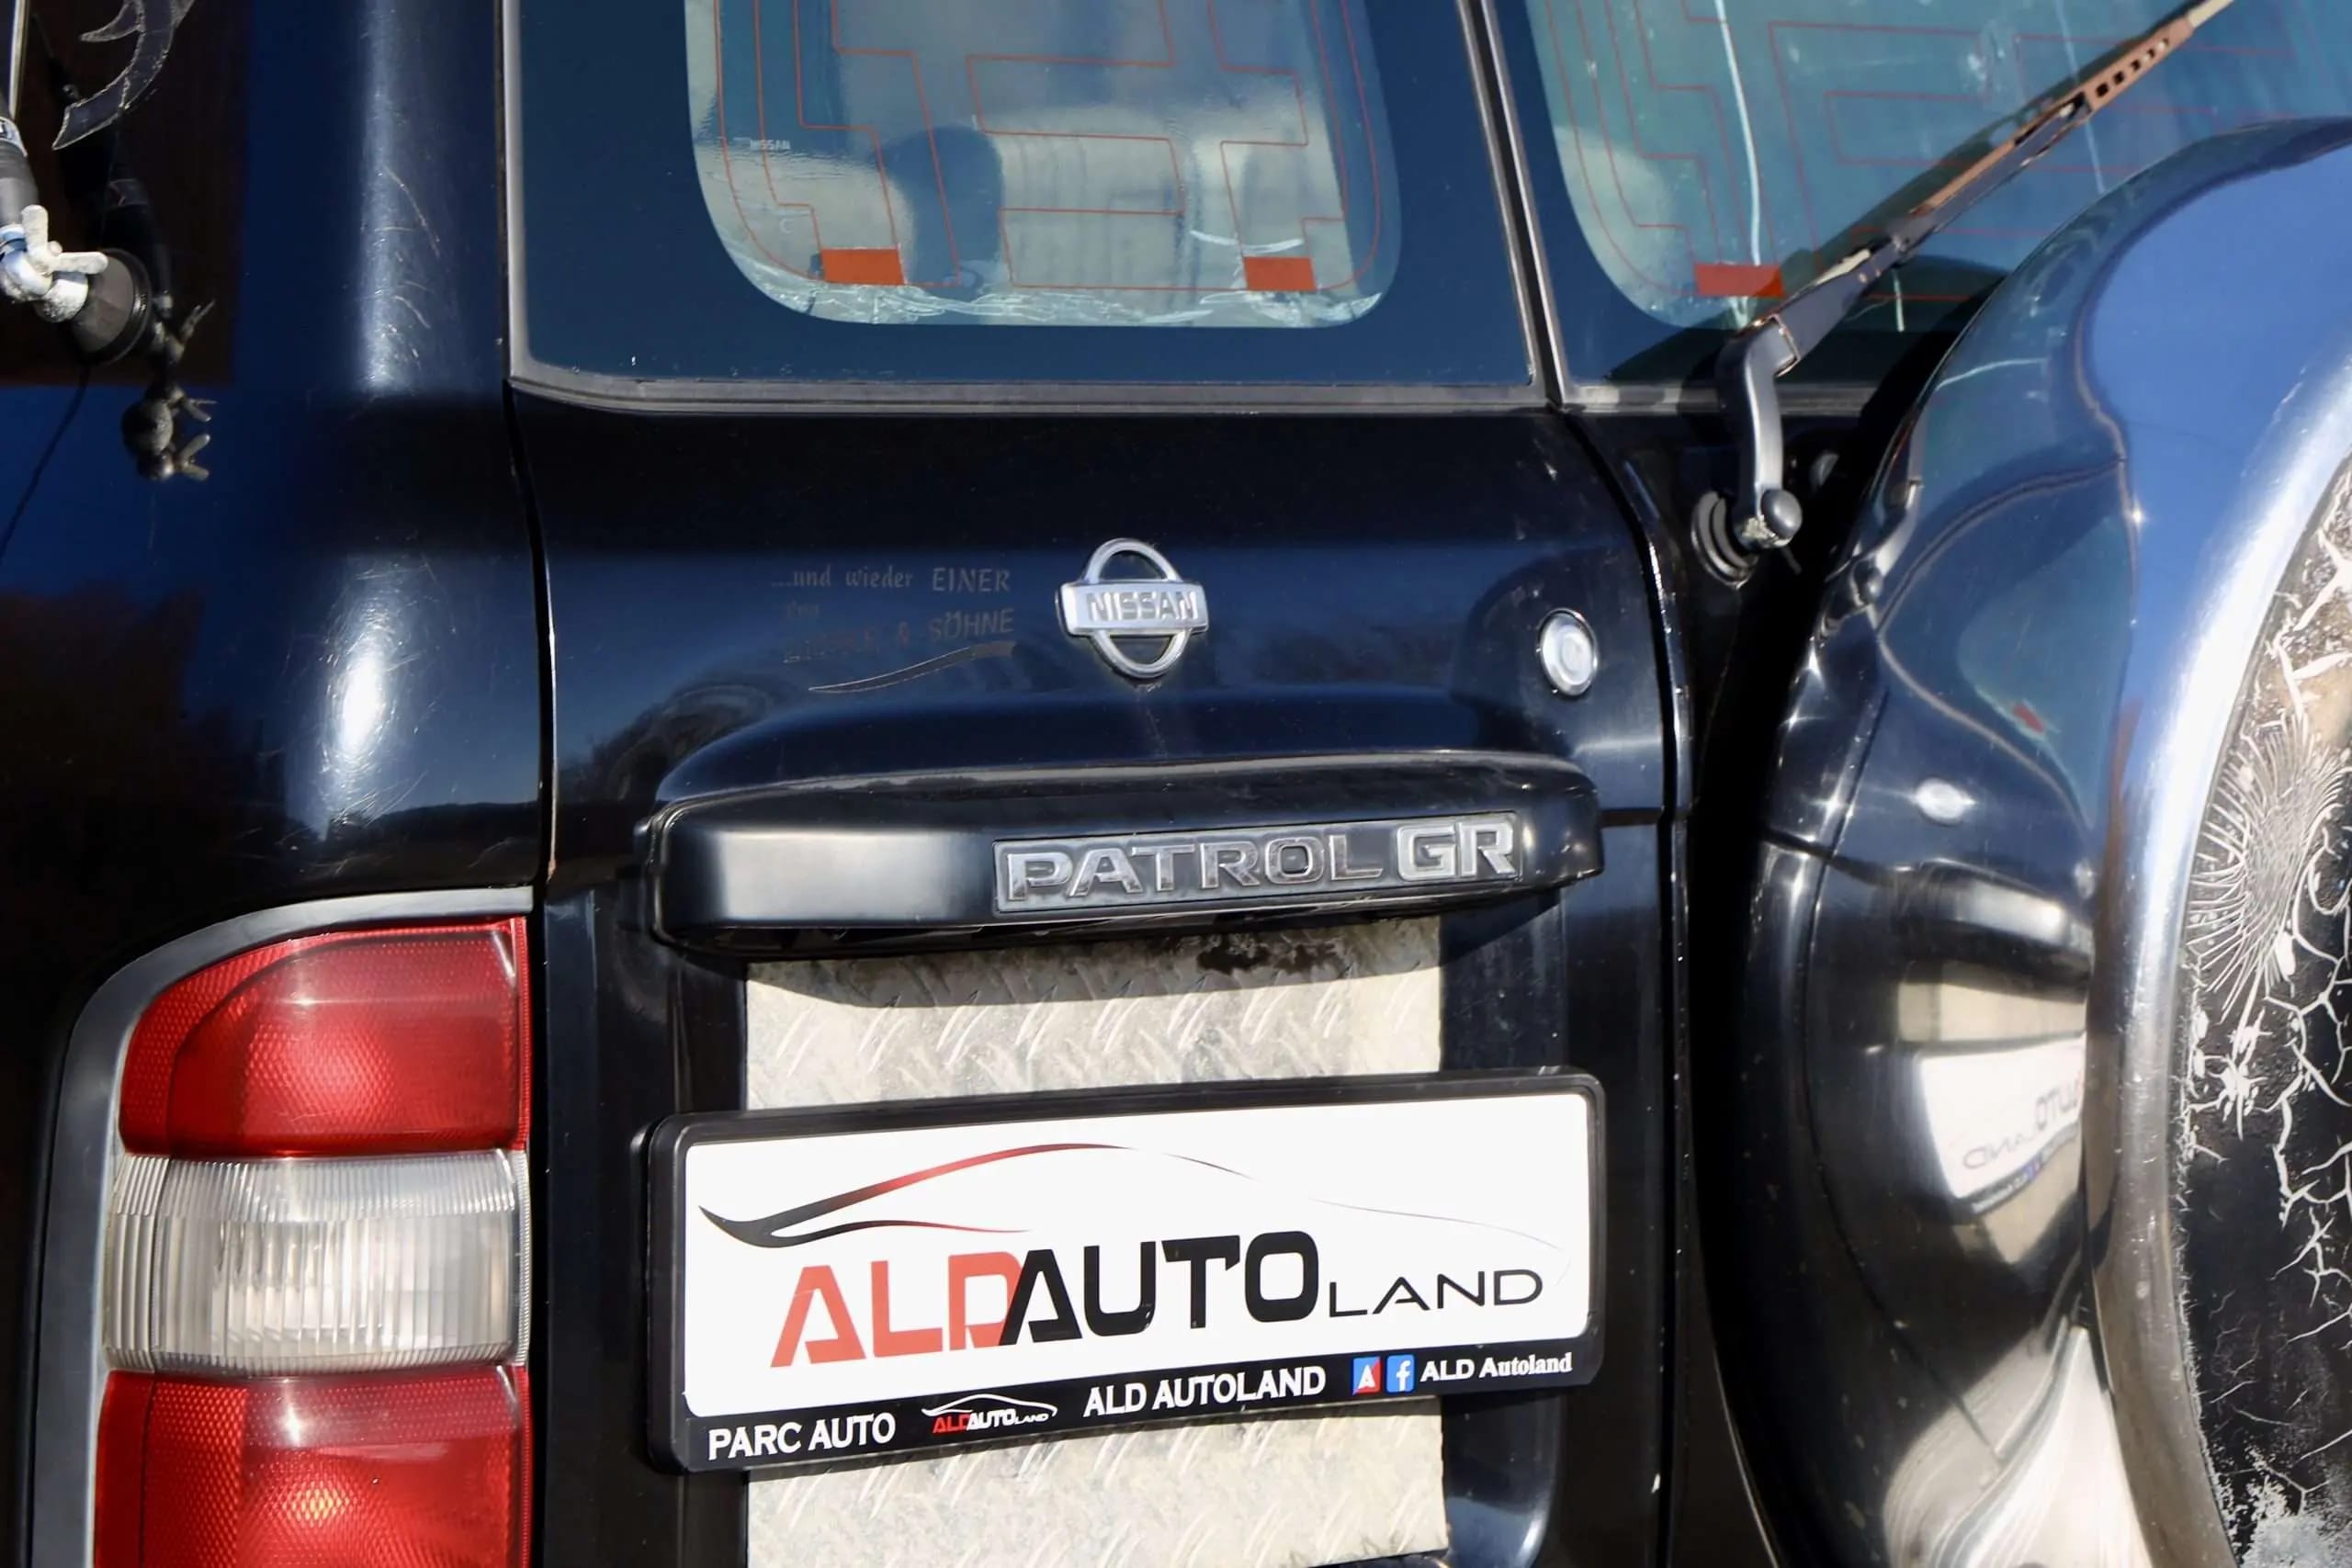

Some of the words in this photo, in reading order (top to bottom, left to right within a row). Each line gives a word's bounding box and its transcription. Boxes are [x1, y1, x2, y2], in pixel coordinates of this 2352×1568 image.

[845, 564, 913, 589] wieder
[931, 567, 1011, 592] EINER
[928, 607, 1016, 642] SÖHNE
[1086, 592, 1198, 622] NISSAN
[1006, 833, 1384, 902] PATROL
[1396, 815, 1517, 883] GR
[1419, 1359, 1476, 1382] ALD
[1479, 1352, 1573, 1378] Autoland
[1082, 1380, 1148, 1417] ALD
[1152, 1365, 1327, 1411] AUTOLAND
[708, 1422, 802, 1461] PARC
[808, 1412, 896, 1450] AUTO
